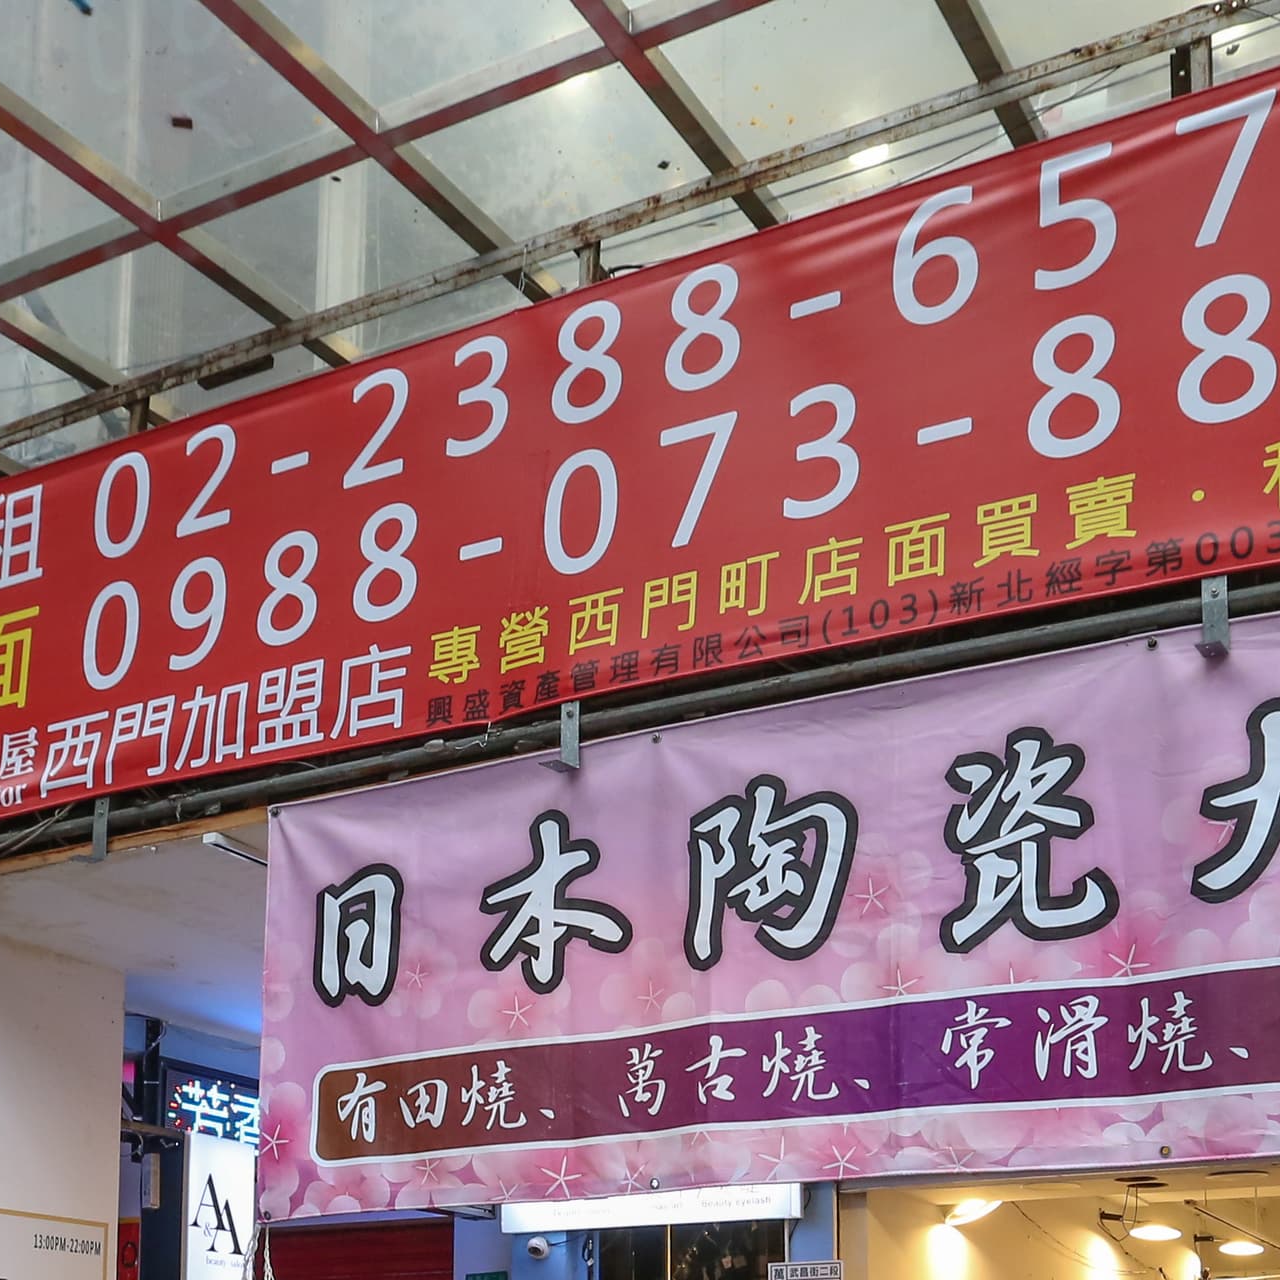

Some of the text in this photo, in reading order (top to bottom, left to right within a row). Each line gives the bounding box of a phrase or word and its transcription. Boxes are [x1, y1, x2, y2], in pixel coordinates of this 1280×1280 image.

[40, 644, 413, 800] 西門加盟店
[33, 1233, 102, 1256] 13:00PM-22:00PM
[789, 1265, 839, 1279] 武昌街二段
